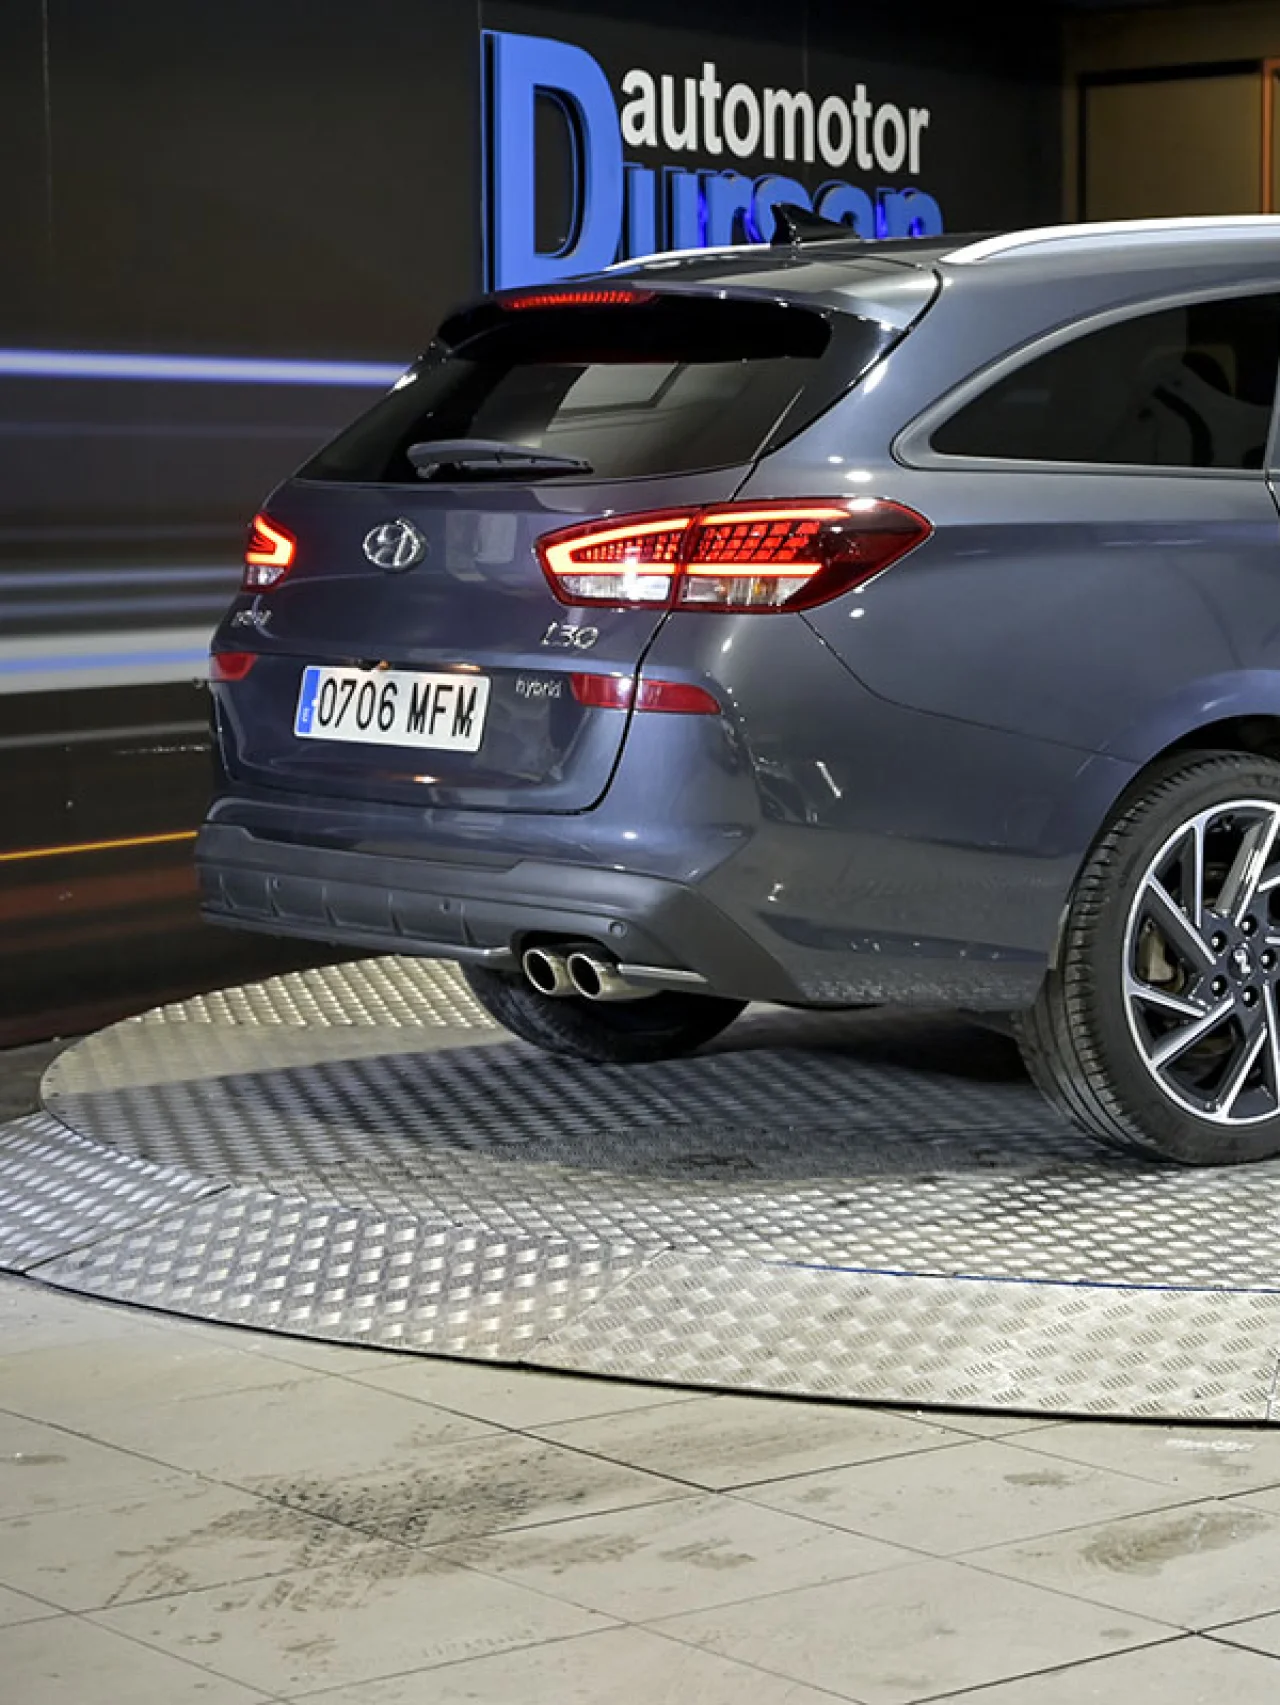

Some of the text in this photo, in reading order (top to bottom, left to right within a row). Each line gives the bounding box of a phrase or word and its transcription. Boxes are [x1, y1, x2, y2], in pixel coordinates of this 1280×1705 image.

[620, 62, 930, 174] automotor
[317, 677, 479, 738] 0706 MFM
